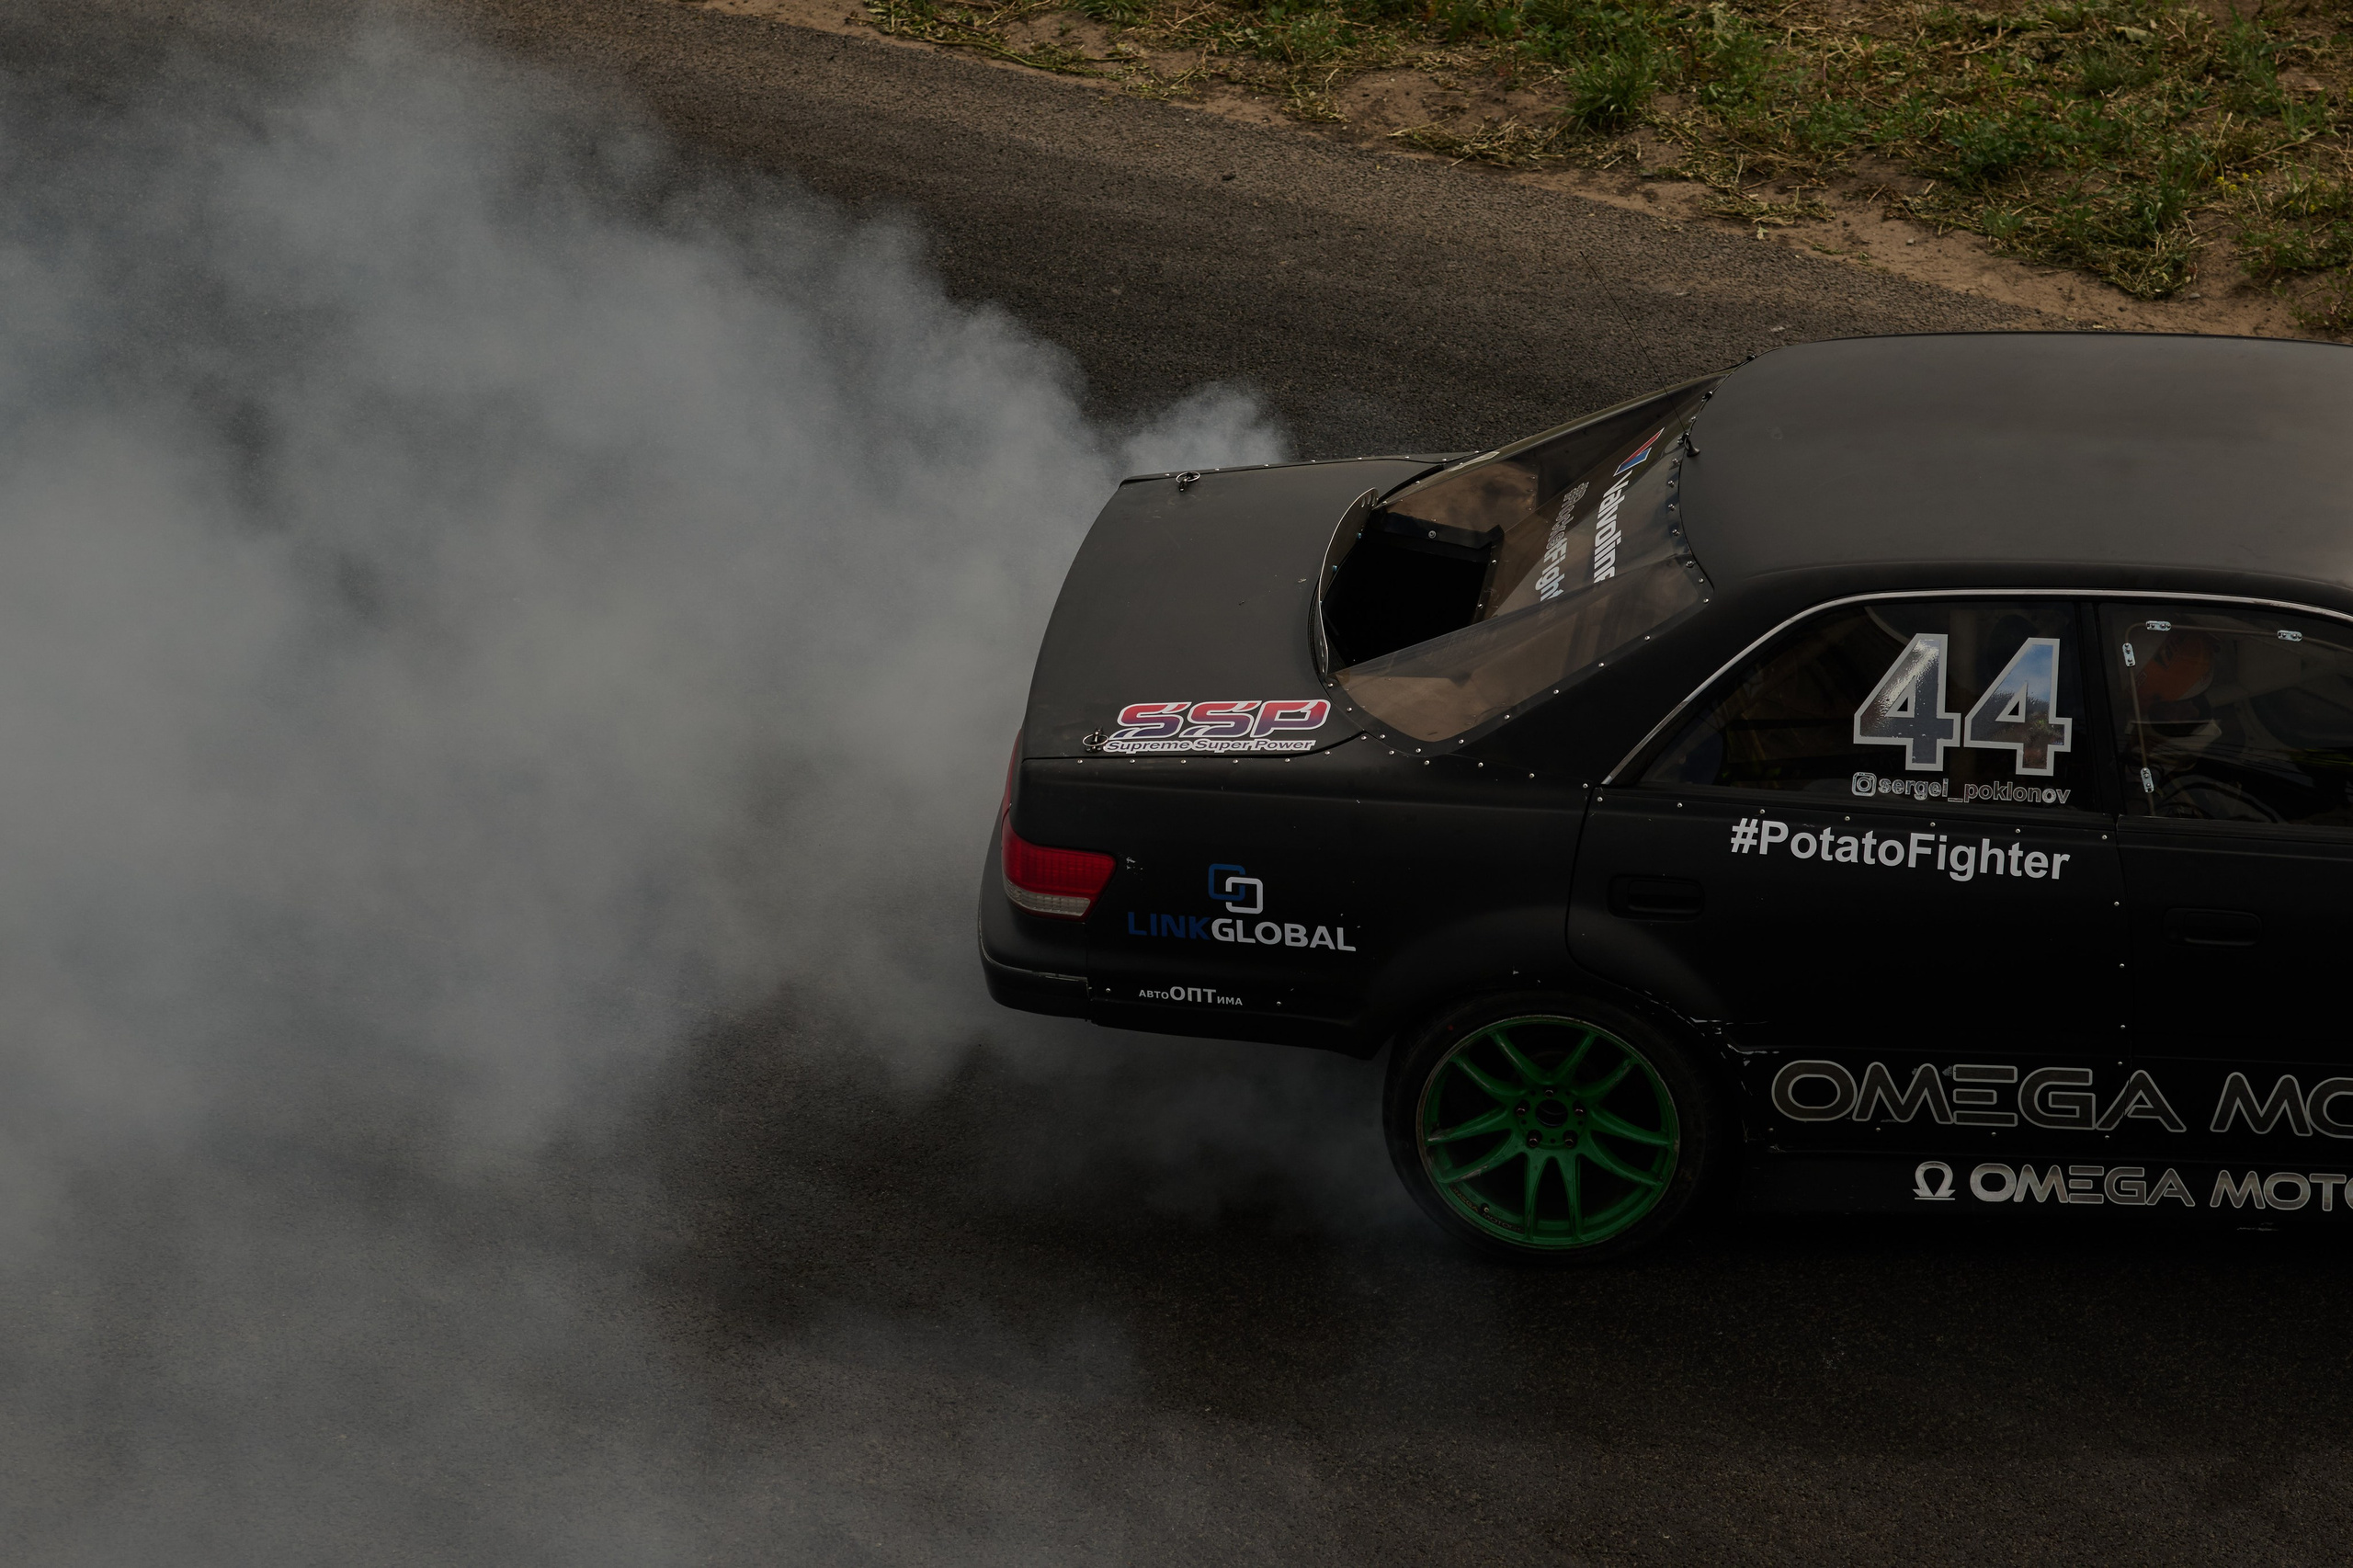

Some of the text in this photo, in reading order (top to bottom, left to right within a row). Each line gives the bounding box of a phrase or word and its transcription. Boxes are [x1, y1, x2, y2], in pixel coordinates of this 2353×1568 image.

[1108, 699, 1331, 739] SSP
[1853, 633, 2073, 777] 44
[1105, 738, 1315, 754] Supreme Super Power
[1730, 818, 2070, 882] #PotatoFighter
[1771, 1060, 2187, 1133] OMEGA
[1969, 1163, 2195, 1208] OMEGA
[2210, 1169, 2353, 1211] MOT
